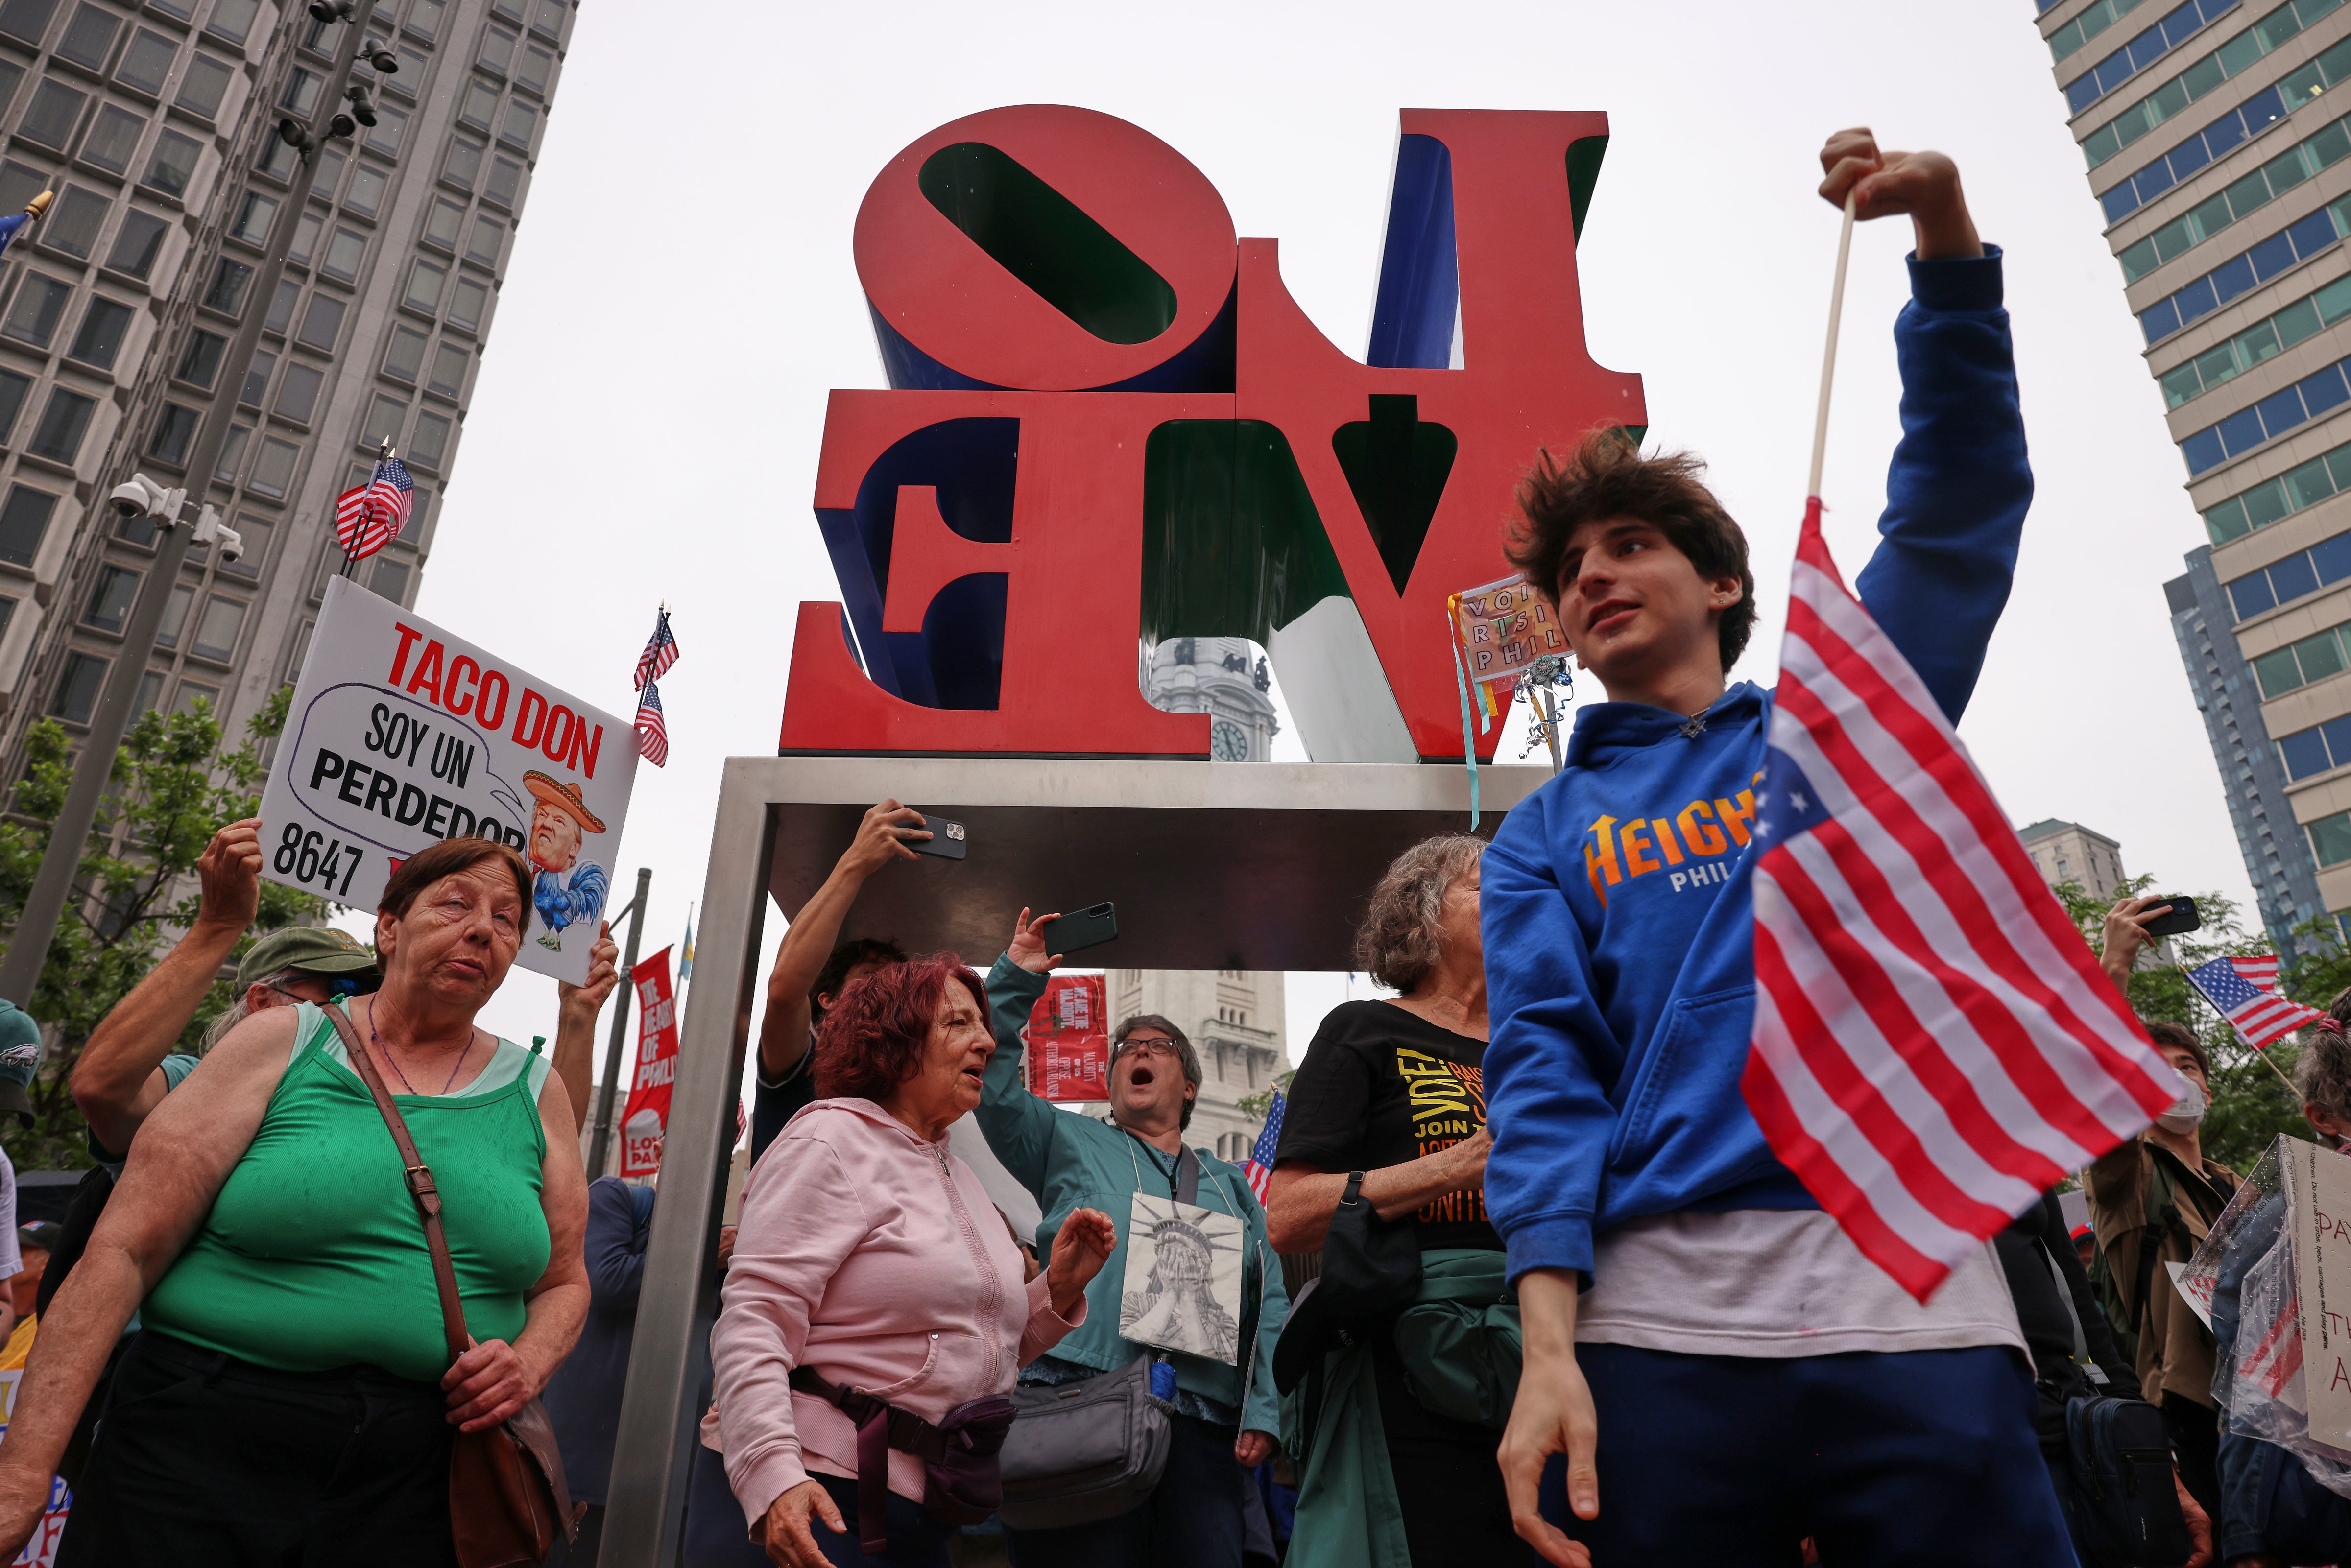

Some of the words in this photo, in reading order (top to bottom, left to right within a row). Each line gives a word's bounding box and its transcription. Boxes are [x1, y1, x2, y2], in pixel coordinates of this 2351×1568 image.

[1468, 585, 1529, 616] VOI
[1473, 605, 1545, 643] RISI
[1477, 630, 1561, 670] PHIL
[388, 621, 509, 731] TACO
[512, 687, 604, 780] DON
[365, 703, 429, 768] SOY
[431, 732, 475, 789] UN
[1583, 771, 1762, 911] HEIGH
[274, 822, 364, 897] 8647
[1670, 862, 1730, 892] PHIL
[640, 977, 660, 1009] THE
[1074, 986, 1088, 998] WE
[643, 998, 675, 1036] HEART
[1075, 999, 1088, 1013] ARE
[1075, 1015, 1089, 1029] THE
[641, 1034, 659, 1064] OF
[1059, 1057, 1071, 1080] OPPOSE
[1075, 1068, 1081, 1077] US
[1084, 1052, 1096, 1082] MAJORITY
[1447, 1061, 1483, 1082] RAIS
[1415, 1120, 1468, 1138] JOIN
[631, 1136, 663, 1151] LO
[631, 1152, 652, 1165] PA
[2312, 1181, 2317, 1191] Do
[2254, 1202, 2267, 1215] Esto
[2267, 1194, 2274, 1203] no
[2318, 1212, 2351, 1245] PA
[2272, 1254, 2279, 1262] de
[2270, 1297, 2277, 1307] No
